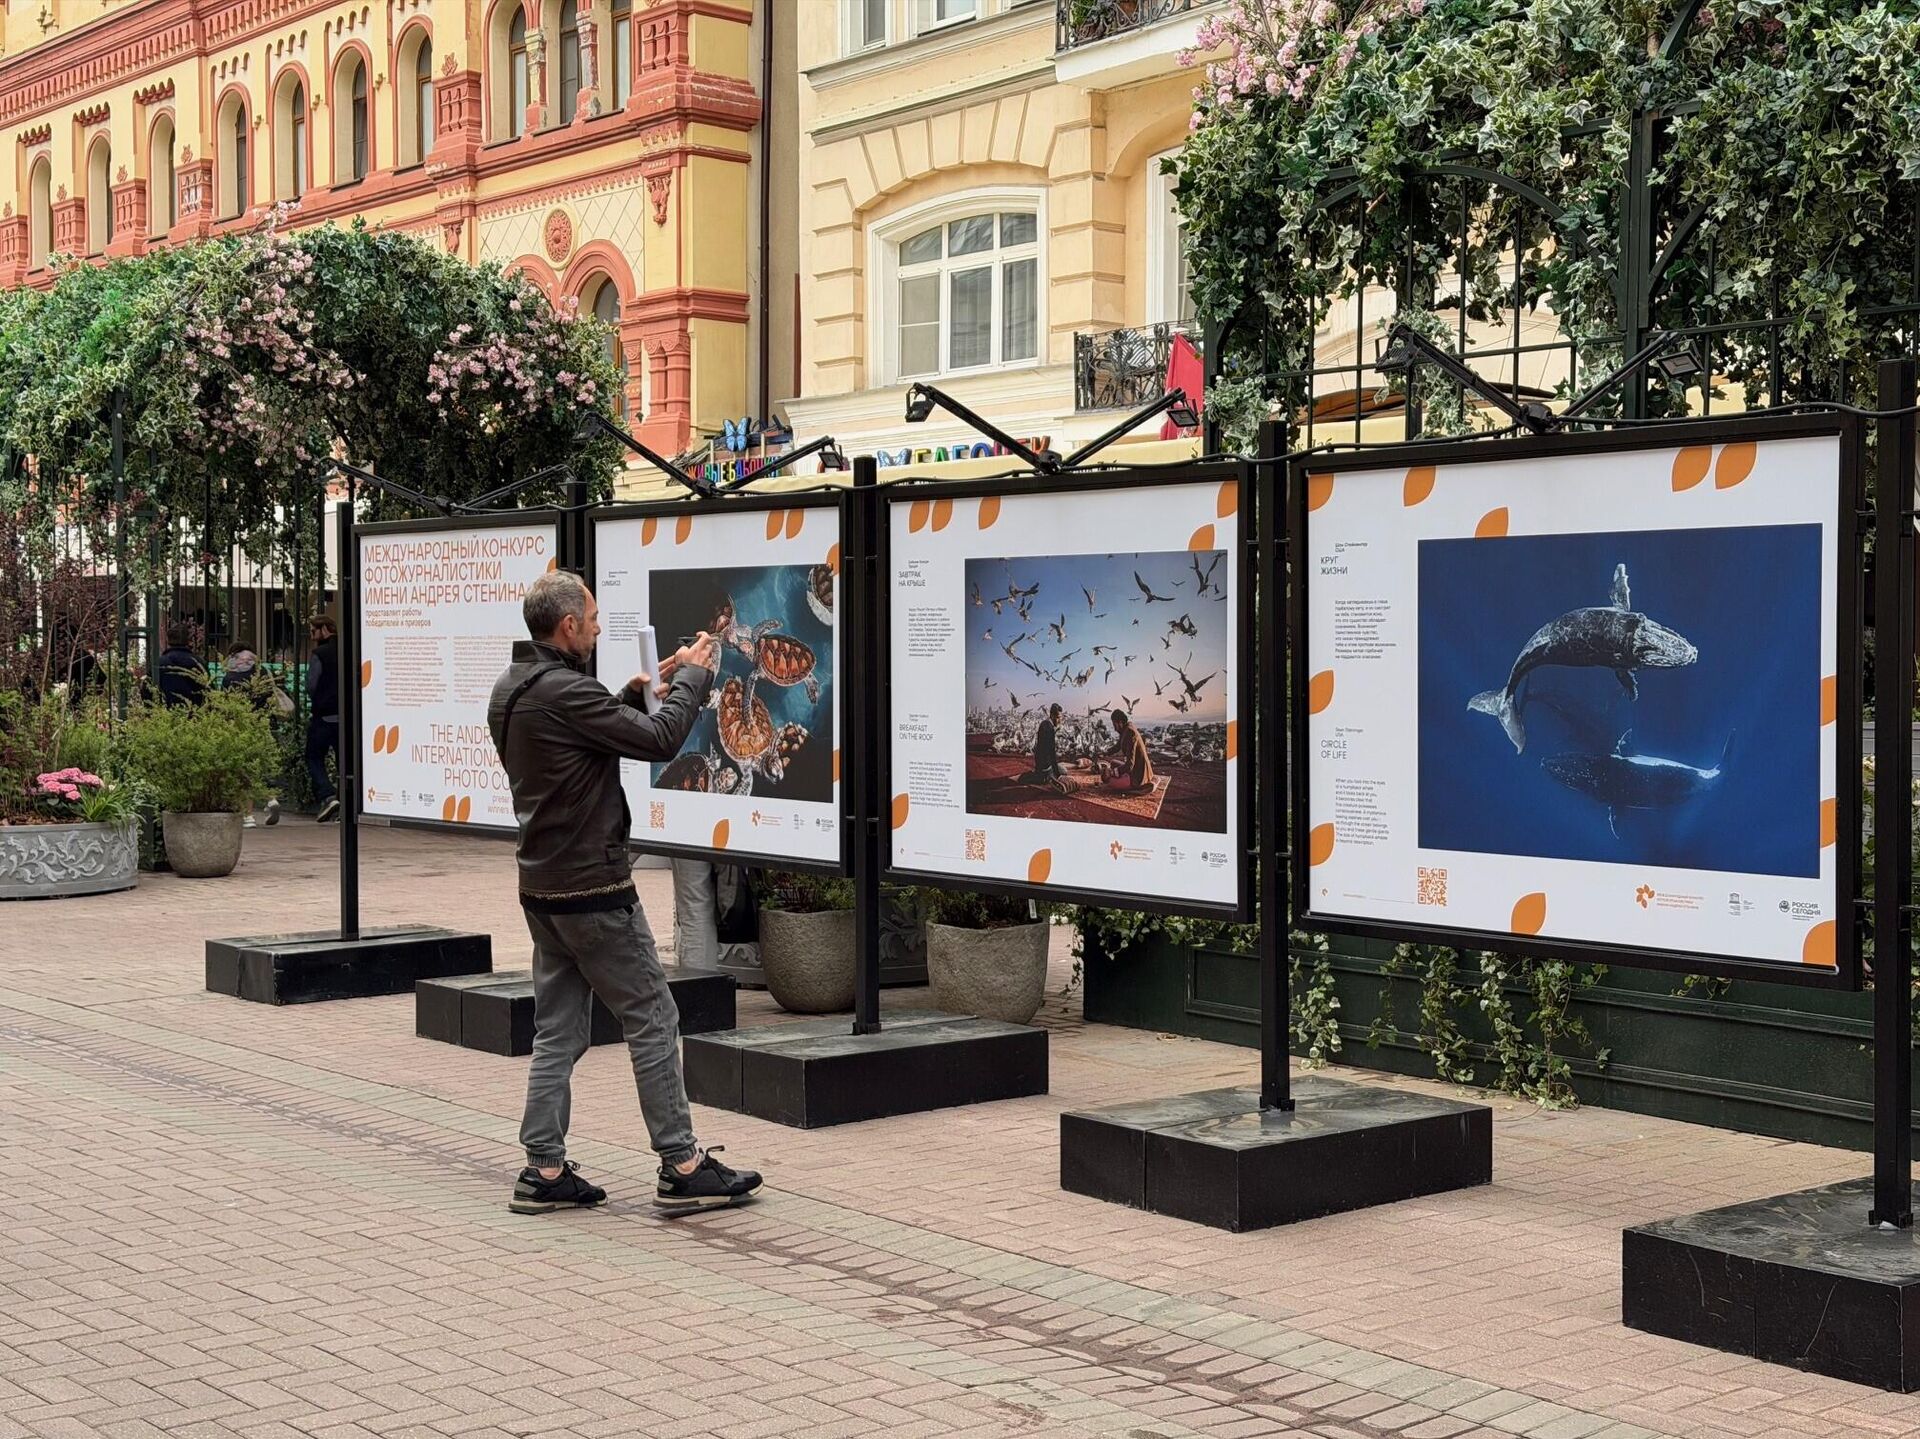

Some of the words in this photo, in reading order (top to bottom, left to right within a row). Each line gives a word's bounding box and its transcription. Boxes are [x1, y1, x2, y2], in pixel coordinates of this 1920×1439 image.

[364, 535, 480, 564] МЕЖДУНАРОДНЫЙ
[482, 536, 544, 558] КОНКУРС
[1320, 556, 1338, 564] КРУГ
[364, 562, 502, 584] ФОТОЖУРНАЛИСТИКИ
[1320, 566, 1348, 575] ЖИЗНИ
[365, 587, 408, 605] ИМЕНИ
[410, 584, 460, 606] АНДРЕЯ
[464, 582, 525, 604] СТЕНИНА
[430, 724, 453, 743] THE
[457, 724, 492, 745] ANDR
[1321, 740, 1347, 749] CIRCLE
[412, 744, 502, 767] INTERNATIONA
[1321, 751, 1331, 759] OF
[1332, 751, 1347, 759] LIFE
[444, 769, 488, 788] PHOTO
[492, 770, 510, 790] CO
